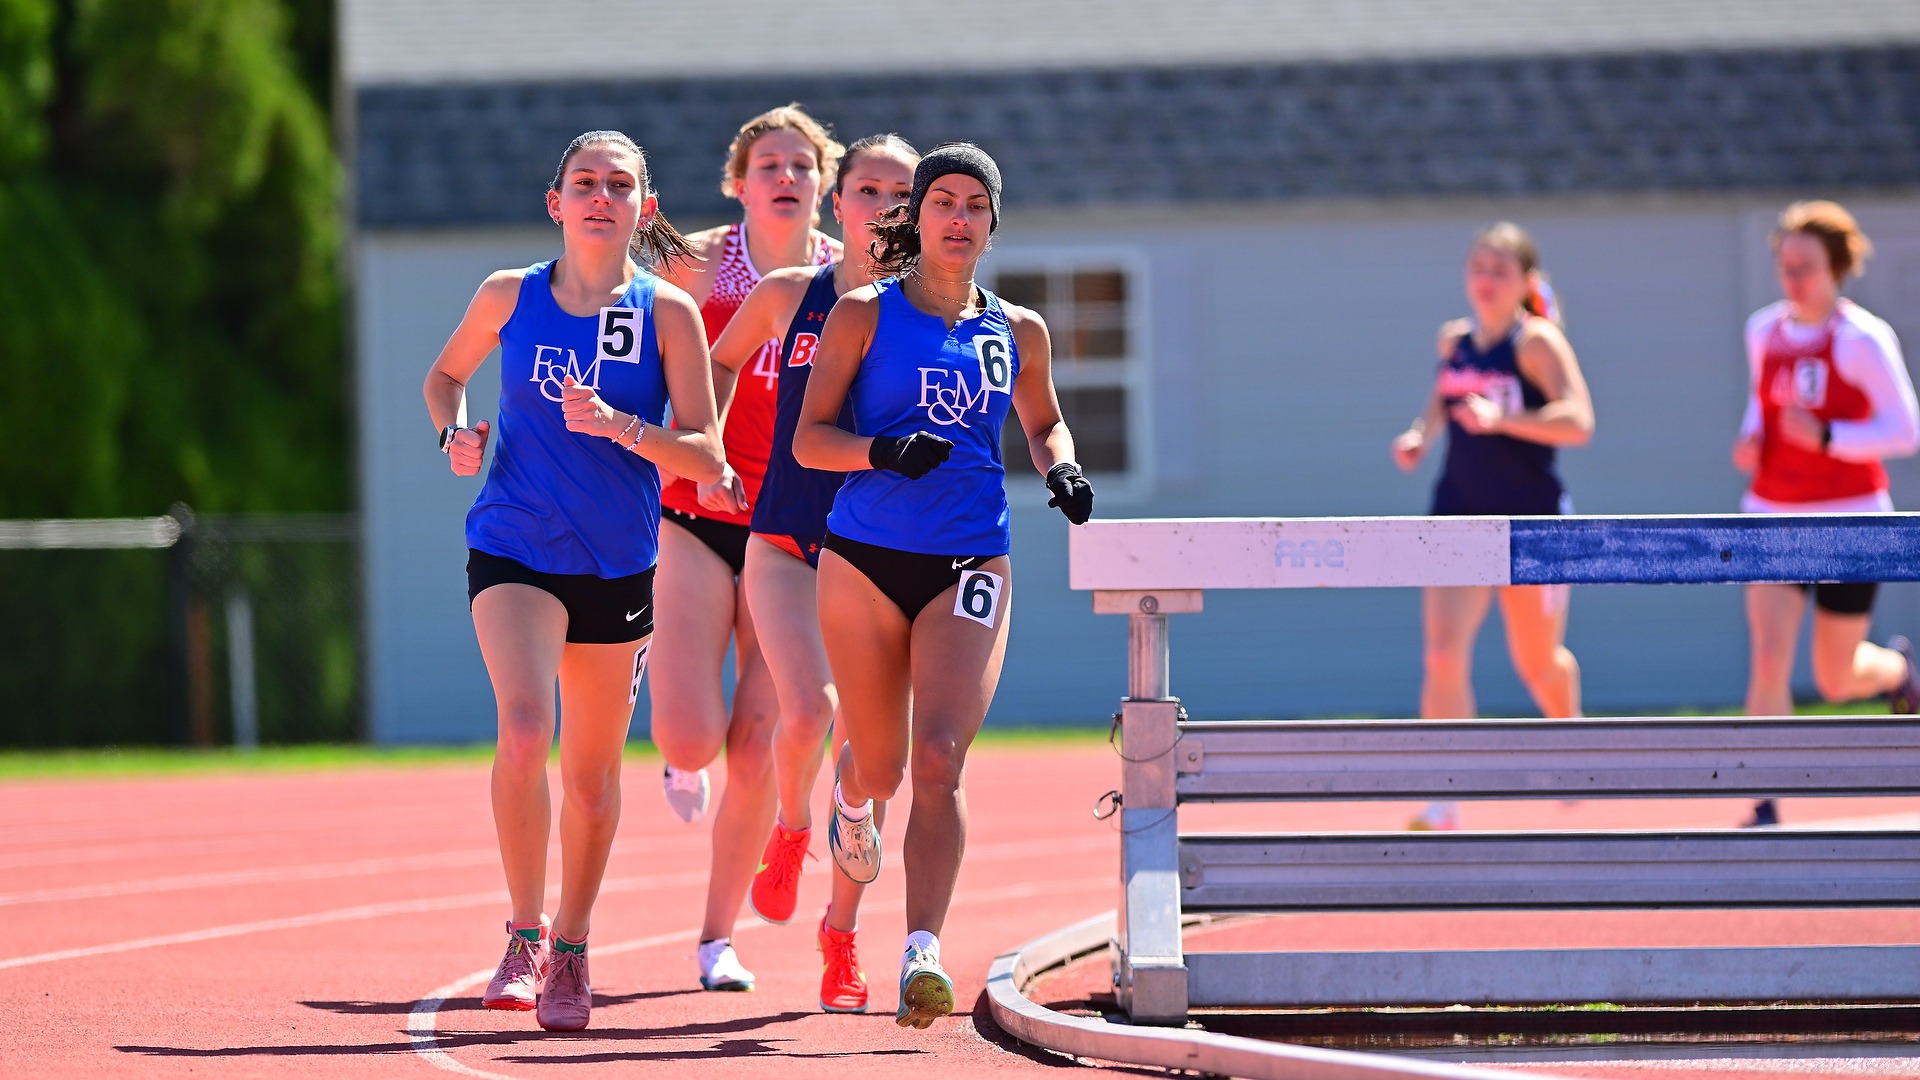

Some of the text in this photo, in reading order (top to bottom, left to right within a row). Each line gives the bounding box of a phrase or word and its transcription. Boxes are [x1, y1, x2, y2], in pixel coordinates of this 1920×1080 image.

[602, 310, 634, 358] 5
[528, 344, 601, 403] F&M
[981, 339, 1009, 389] 6
[916, 366, 988, 429] F&M
[961, 572, 996, 619] 6
